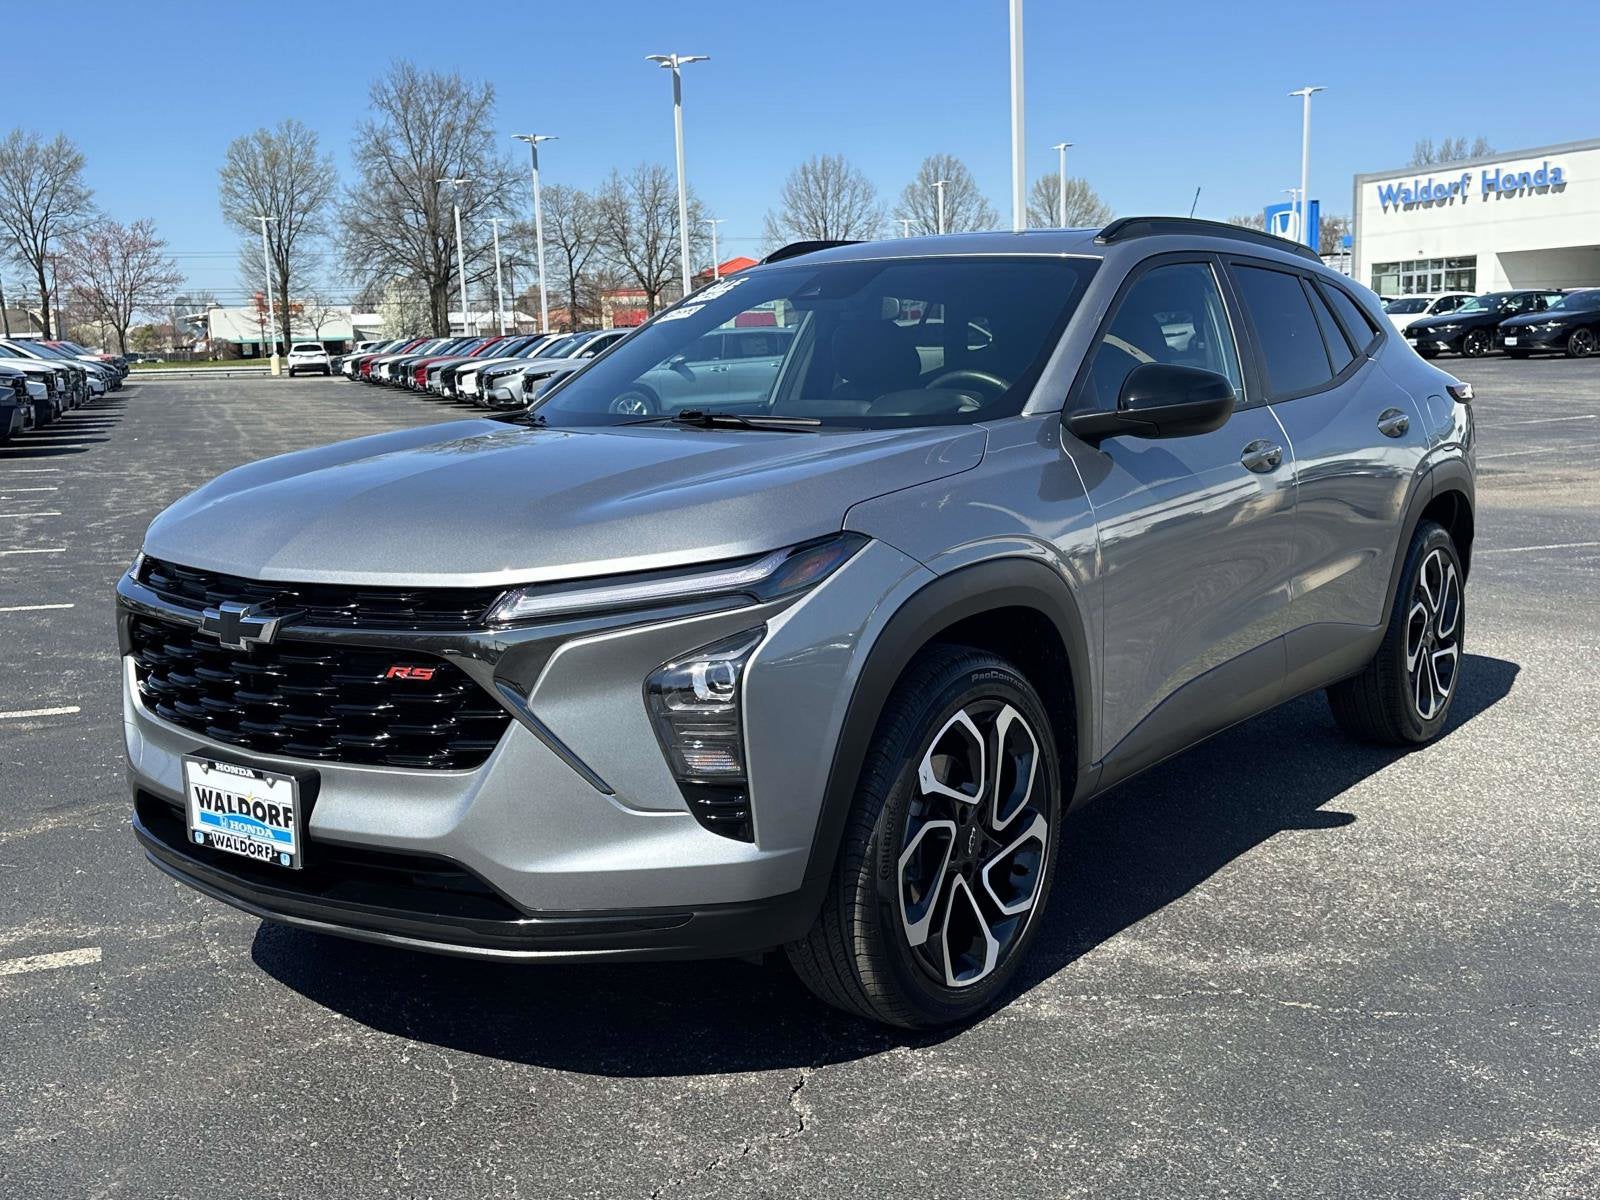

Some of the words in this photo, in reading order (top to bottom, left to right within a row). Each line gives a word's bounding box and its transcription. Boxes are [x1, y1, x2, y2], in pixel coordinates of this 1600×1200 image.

[1377, 171, 1471, 206] Waldorf
[1481, 161, 1565, 195] Honda
[386, 666, 435, 680] RS
[214, 762, 256, 778] HONDA
[194, 786, 293, 828] WALDORF
[230, 819, 275, 839] HONDA
[213, 832, 272, 859] WALDORF
